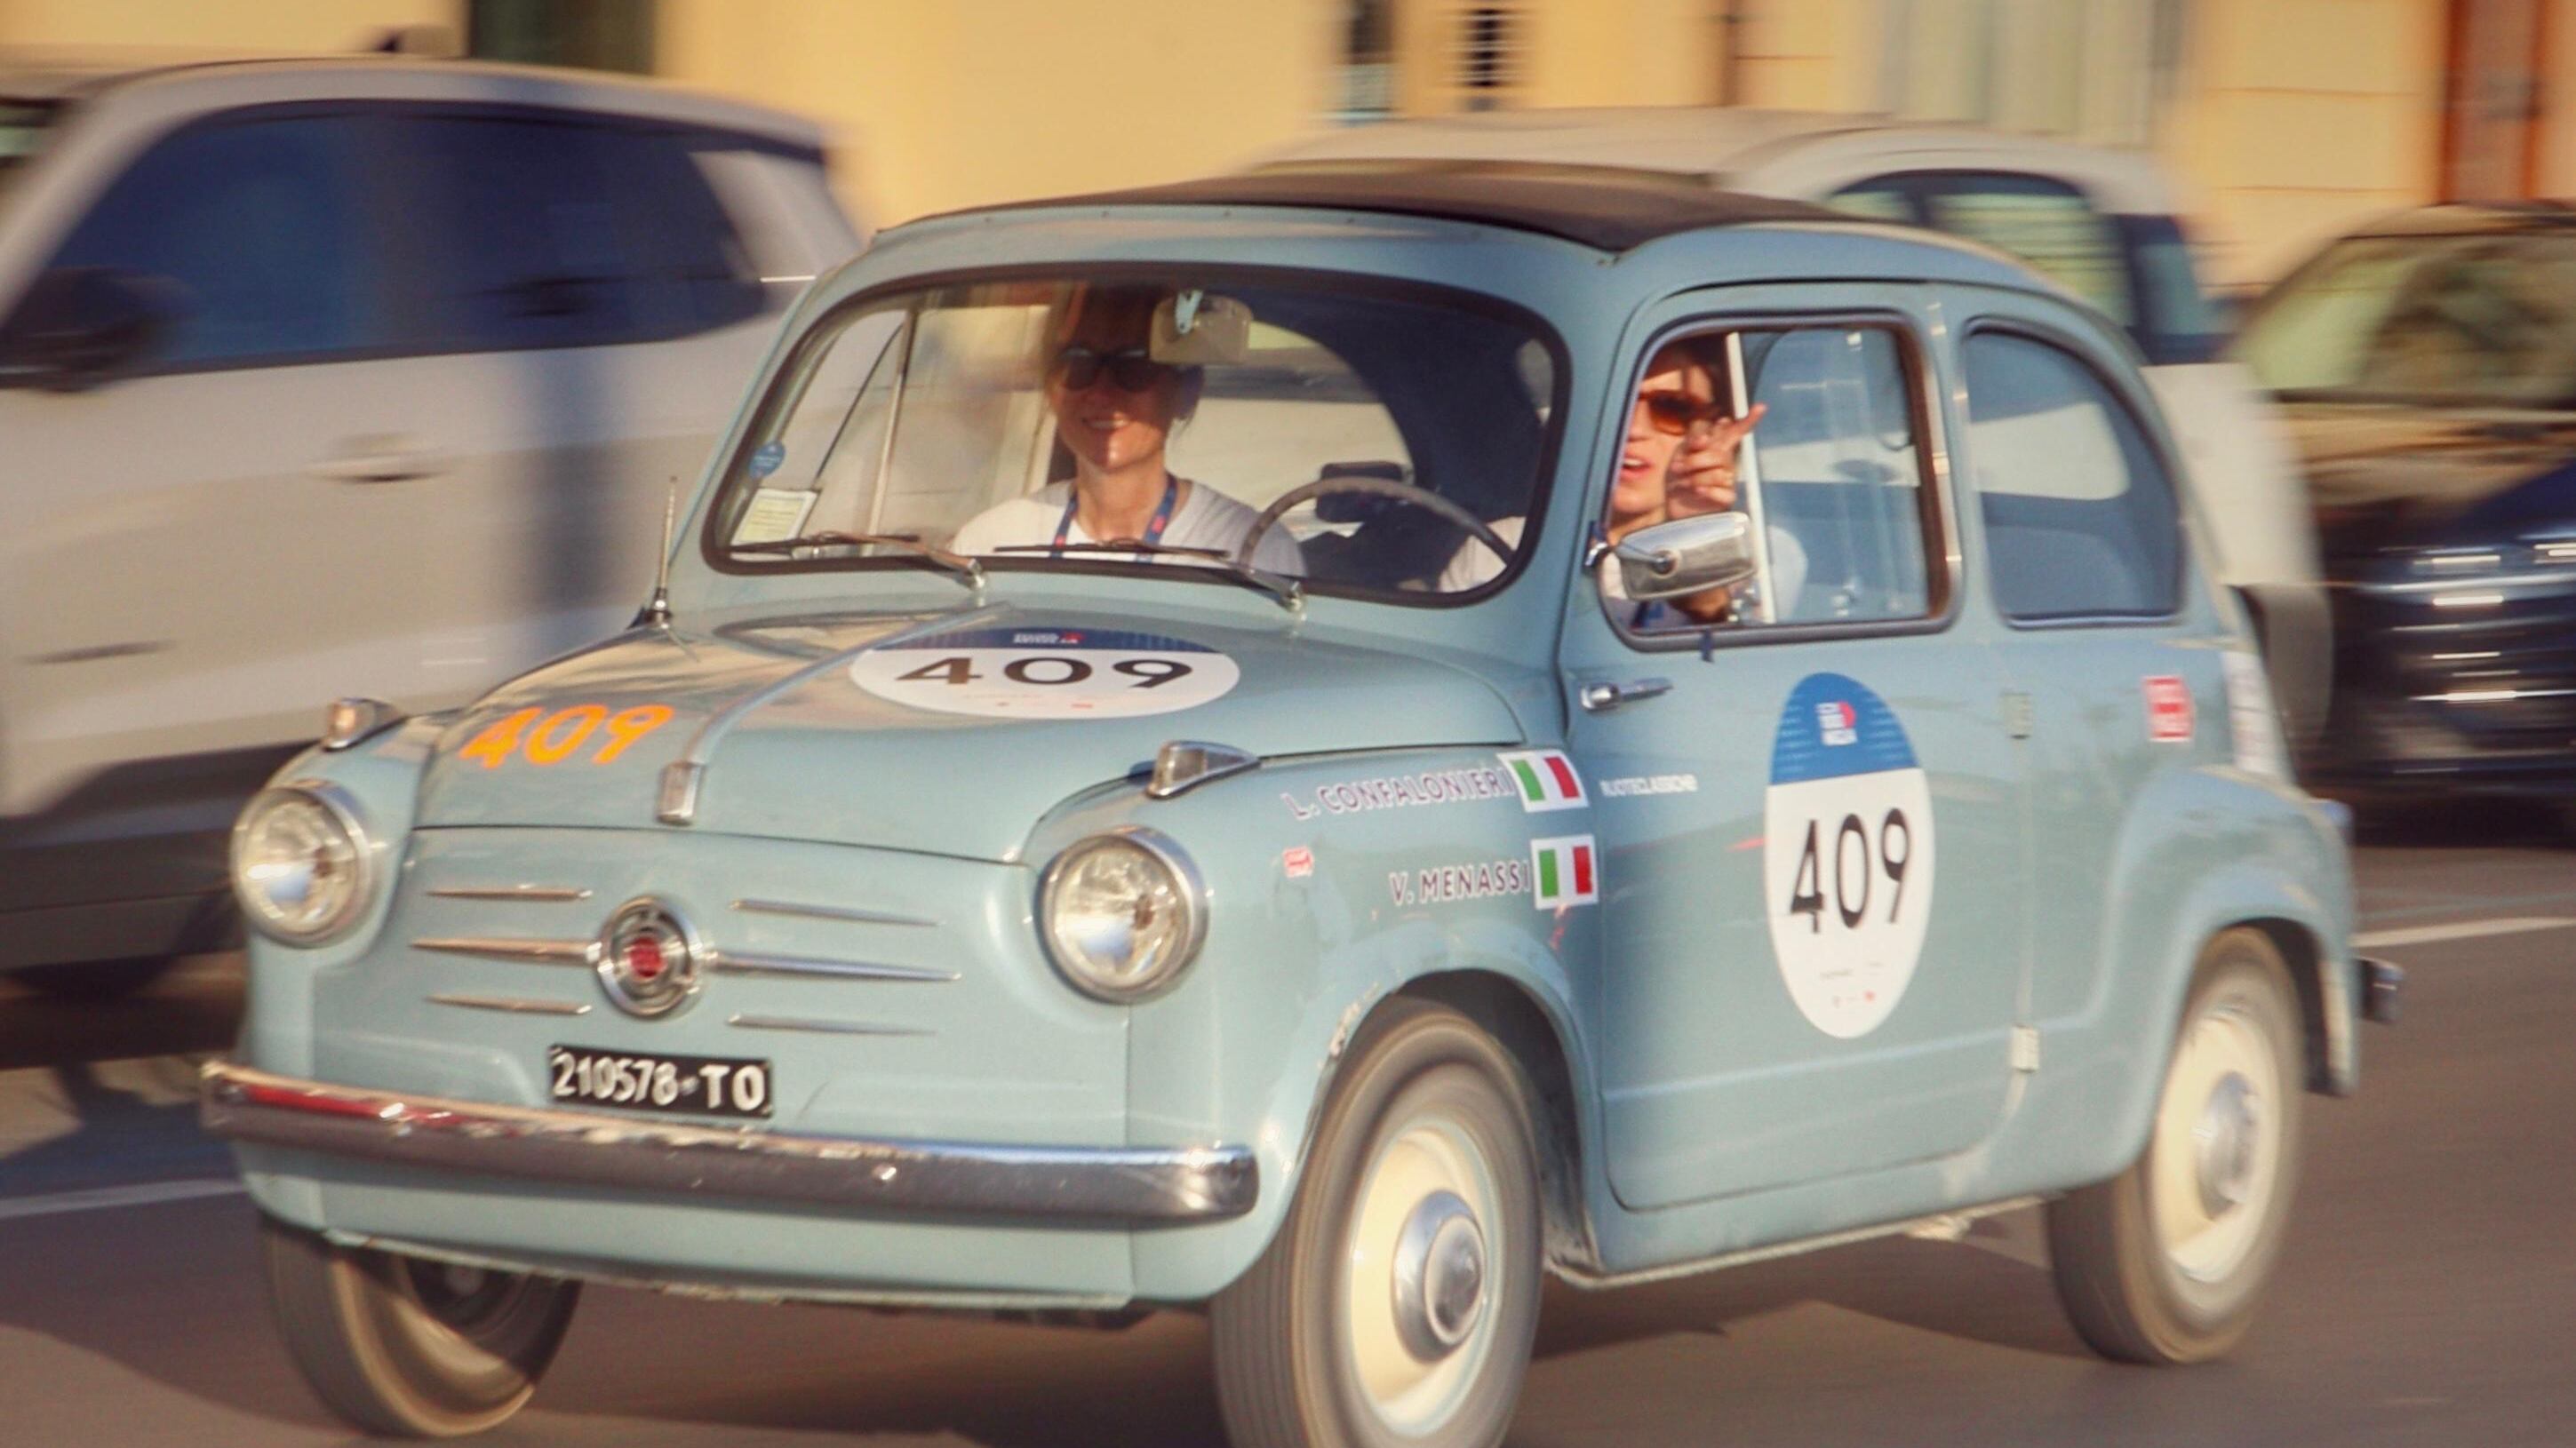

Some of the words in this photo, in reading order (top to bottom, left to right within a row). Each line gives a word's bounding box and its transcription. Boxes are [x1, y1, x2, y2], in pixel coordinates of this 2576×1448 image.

[895, 656, 1193, 689] 409
[457, 704, 674, 770] 409
[1281, 792, 1321, 821] L.
[1318, 767, 1516, 815] CONFALONIERI
[1388, 871, 1416, 906] V.
[1420, 858, 1533, 904] MENASSI
[1789, 807, 1912, 935] 409
